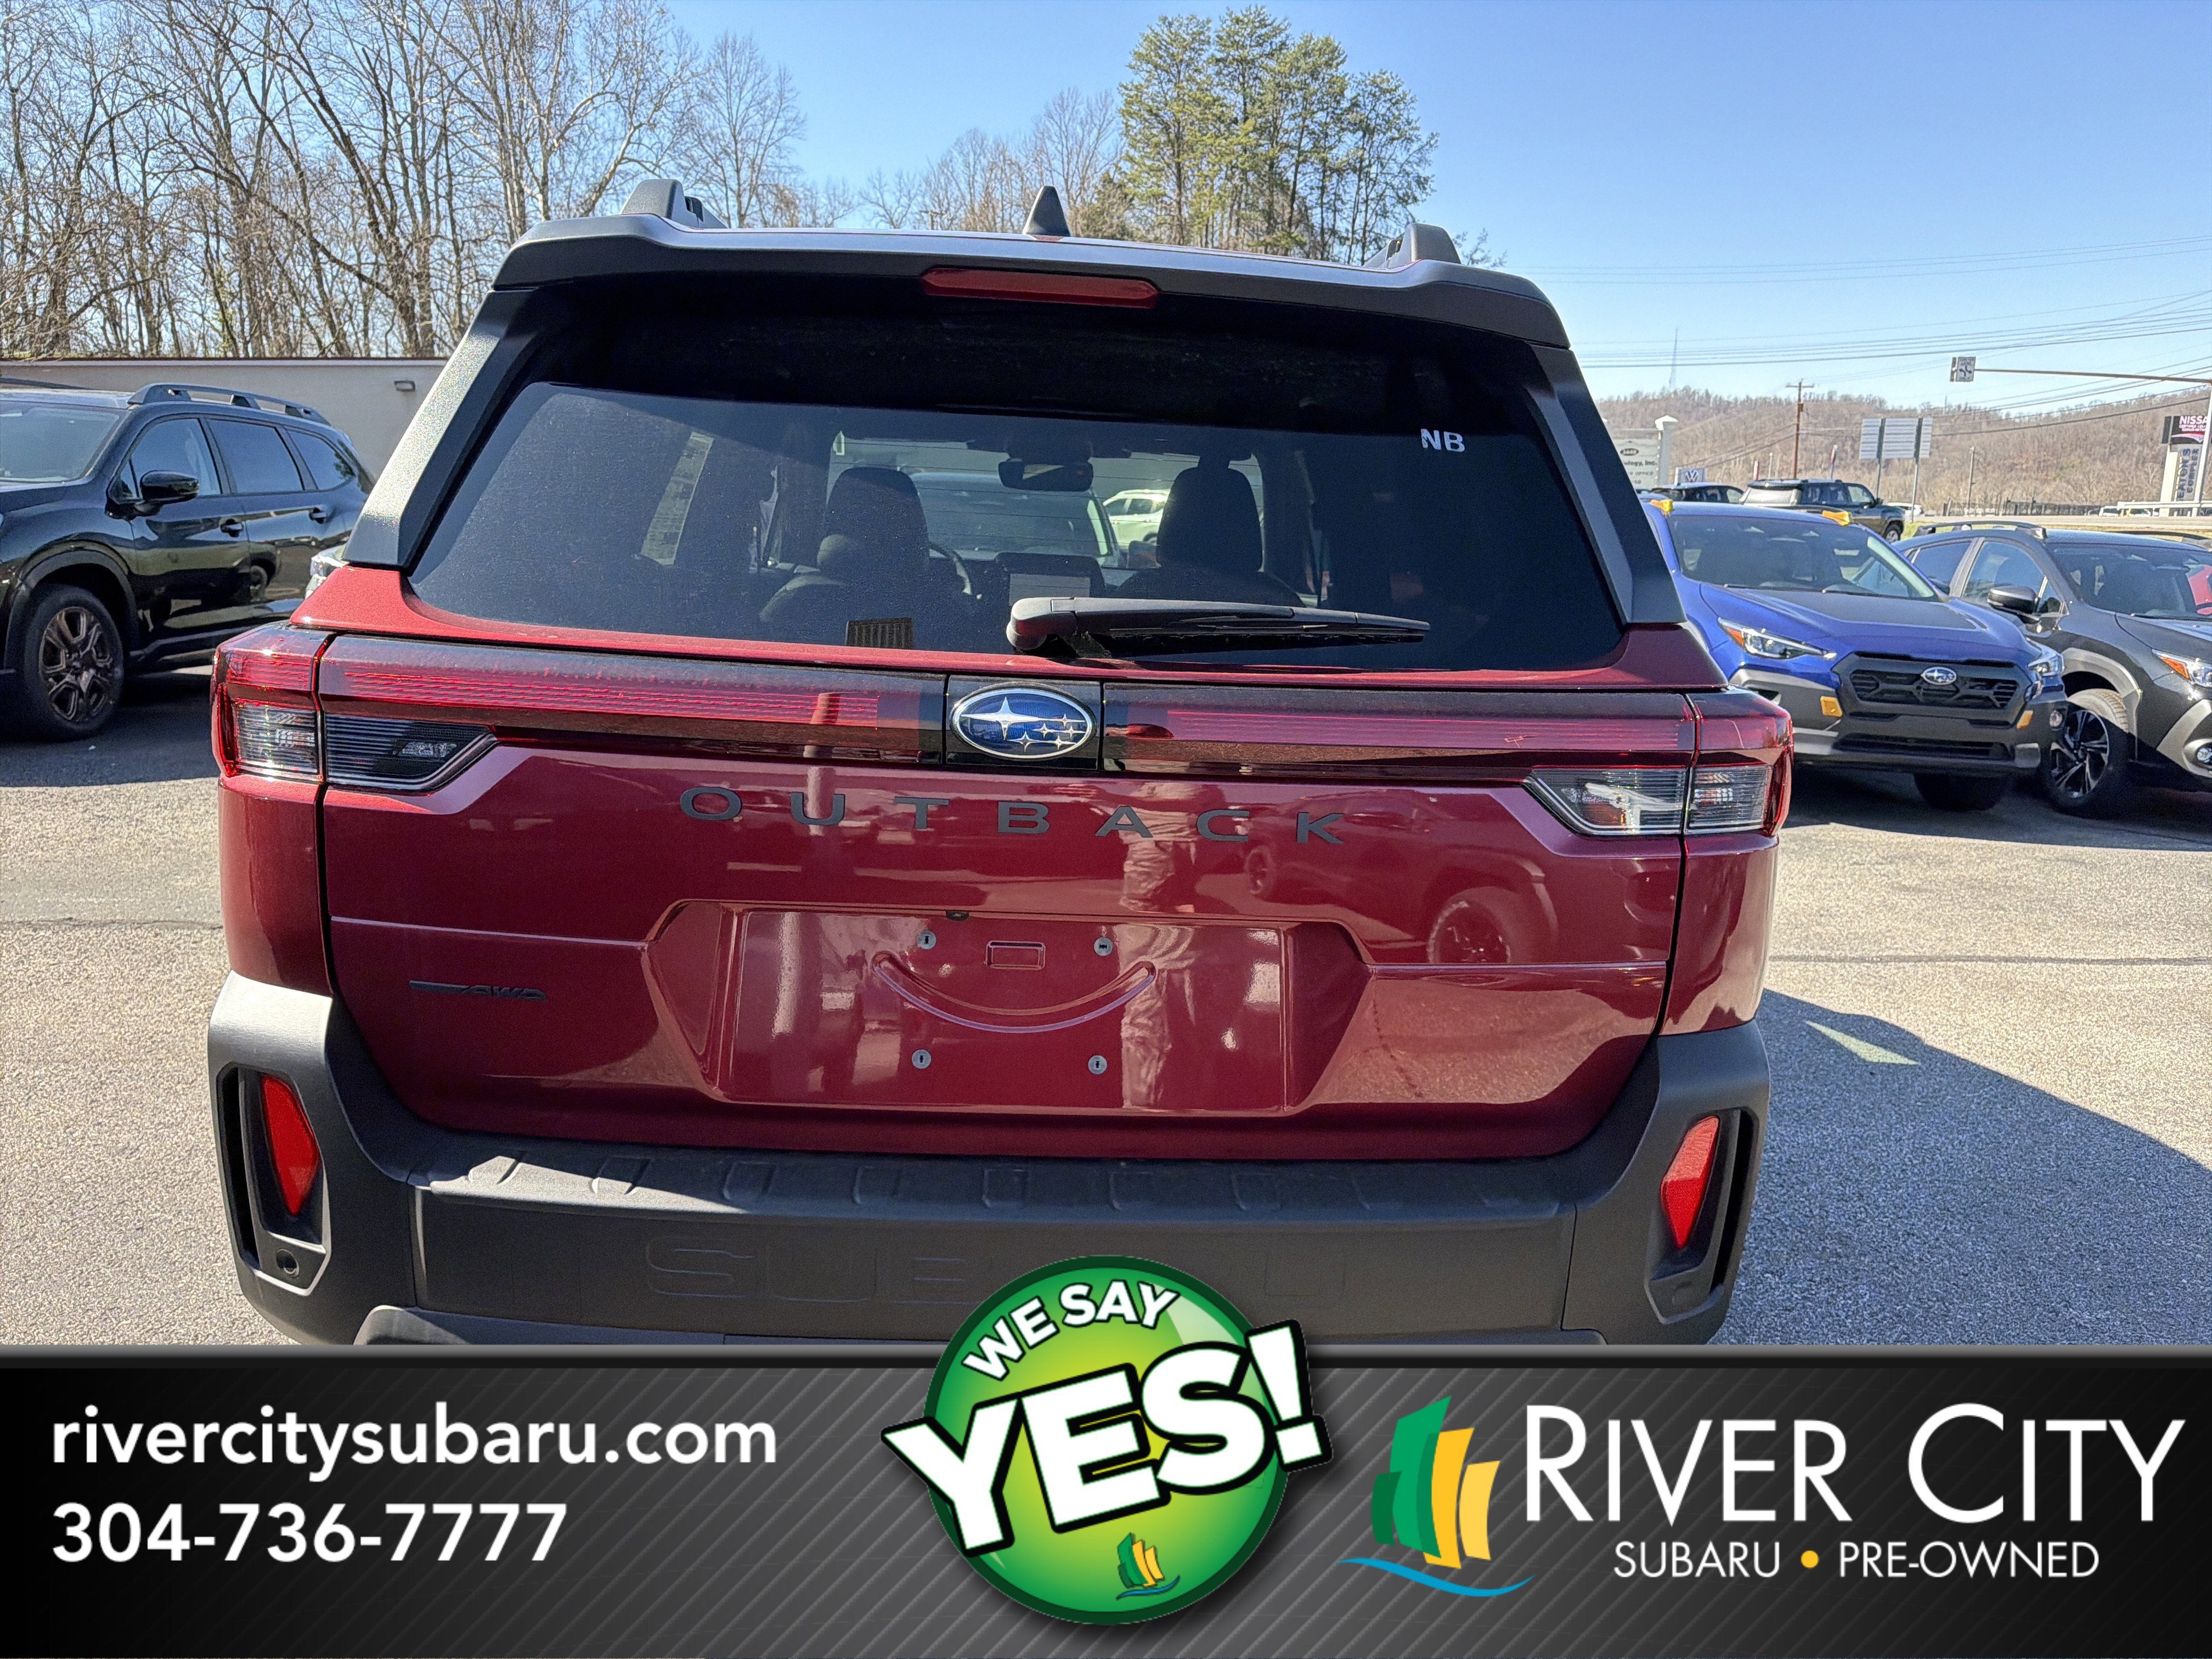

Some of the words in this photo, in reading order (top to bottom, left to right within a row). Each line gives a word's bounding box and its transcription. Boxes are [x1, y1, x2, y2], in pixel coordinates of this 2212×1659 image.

[2180, 415, 2208, 425] NISSA
[1420, 428, 1465, 452] NB
[2187, 448, 2199, 493] COMPLEX
[680, 786, 1345, 845] OUTBACK
